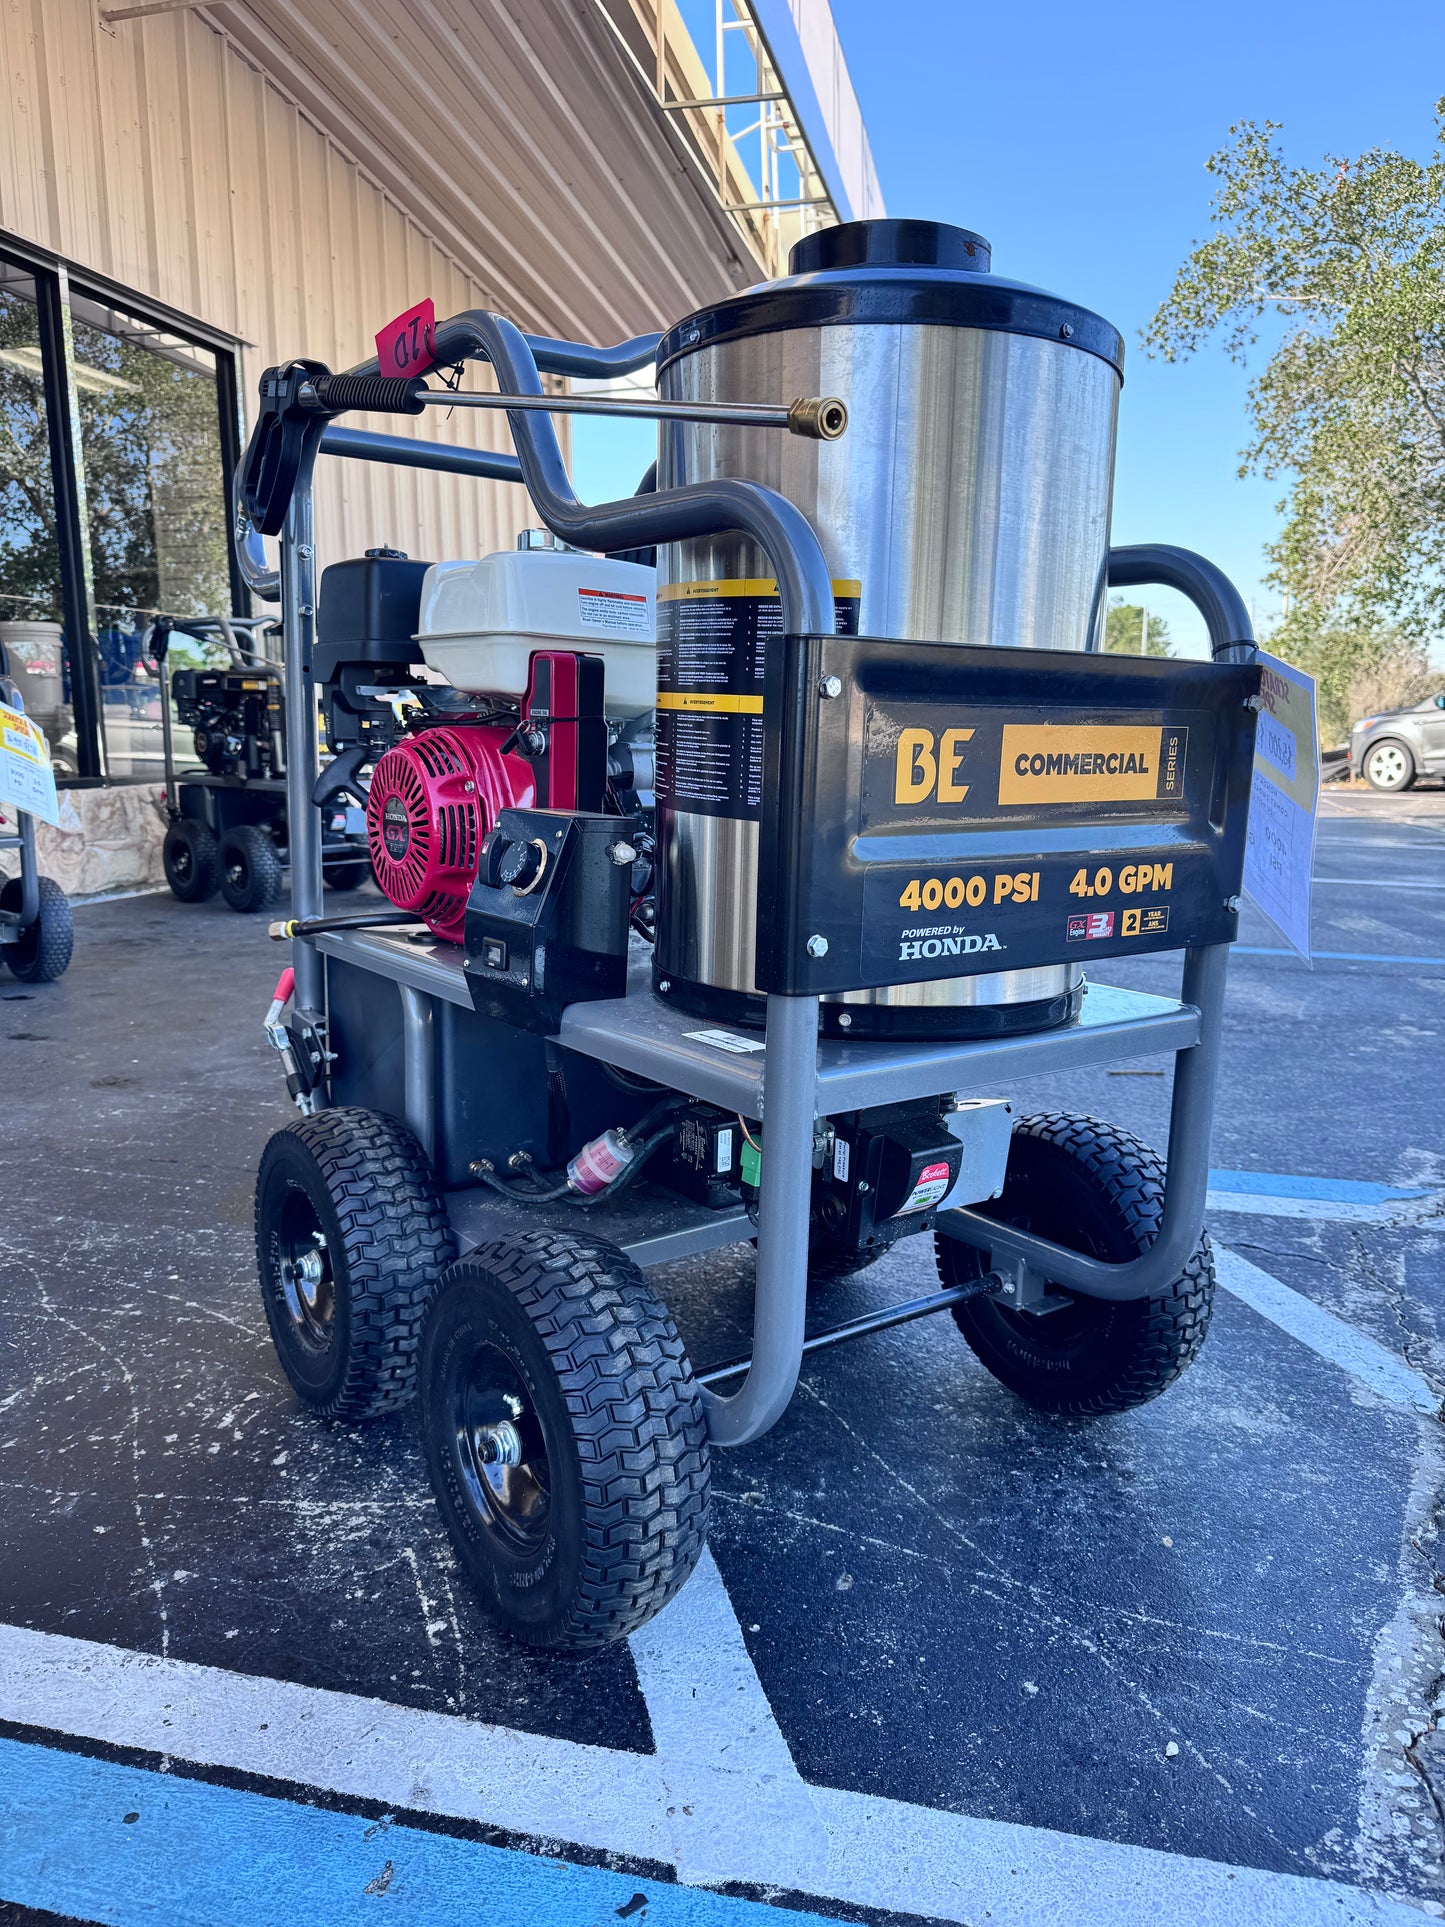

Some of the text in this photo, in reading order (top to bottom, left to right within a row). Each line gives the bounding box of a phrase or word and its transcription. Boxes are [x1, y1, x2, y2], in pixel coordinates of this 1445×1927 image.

[895, 727, 976, 805] BE
[1014, 752, 1149, 777] COMMERCIAL
[1165, 736, 1179, 791] SERIES
[385, 812, 407, 823] HONDA
[386, 825, 406, 842] GX
[899, 862, 1174, 912] 4000 PSI 4.0 GPM
[901, 925, 965, 939] POWERED by
[1069, 919, 1087, 929] GX
[1089, 914, 1109, 935] 3
[1126, 913, 1137, 932] 2
[1069, 928, 1086, 937] Engine
[898, 933, 1002, 961] HONDA
[921, 1166, 948, 1180] Beckett
